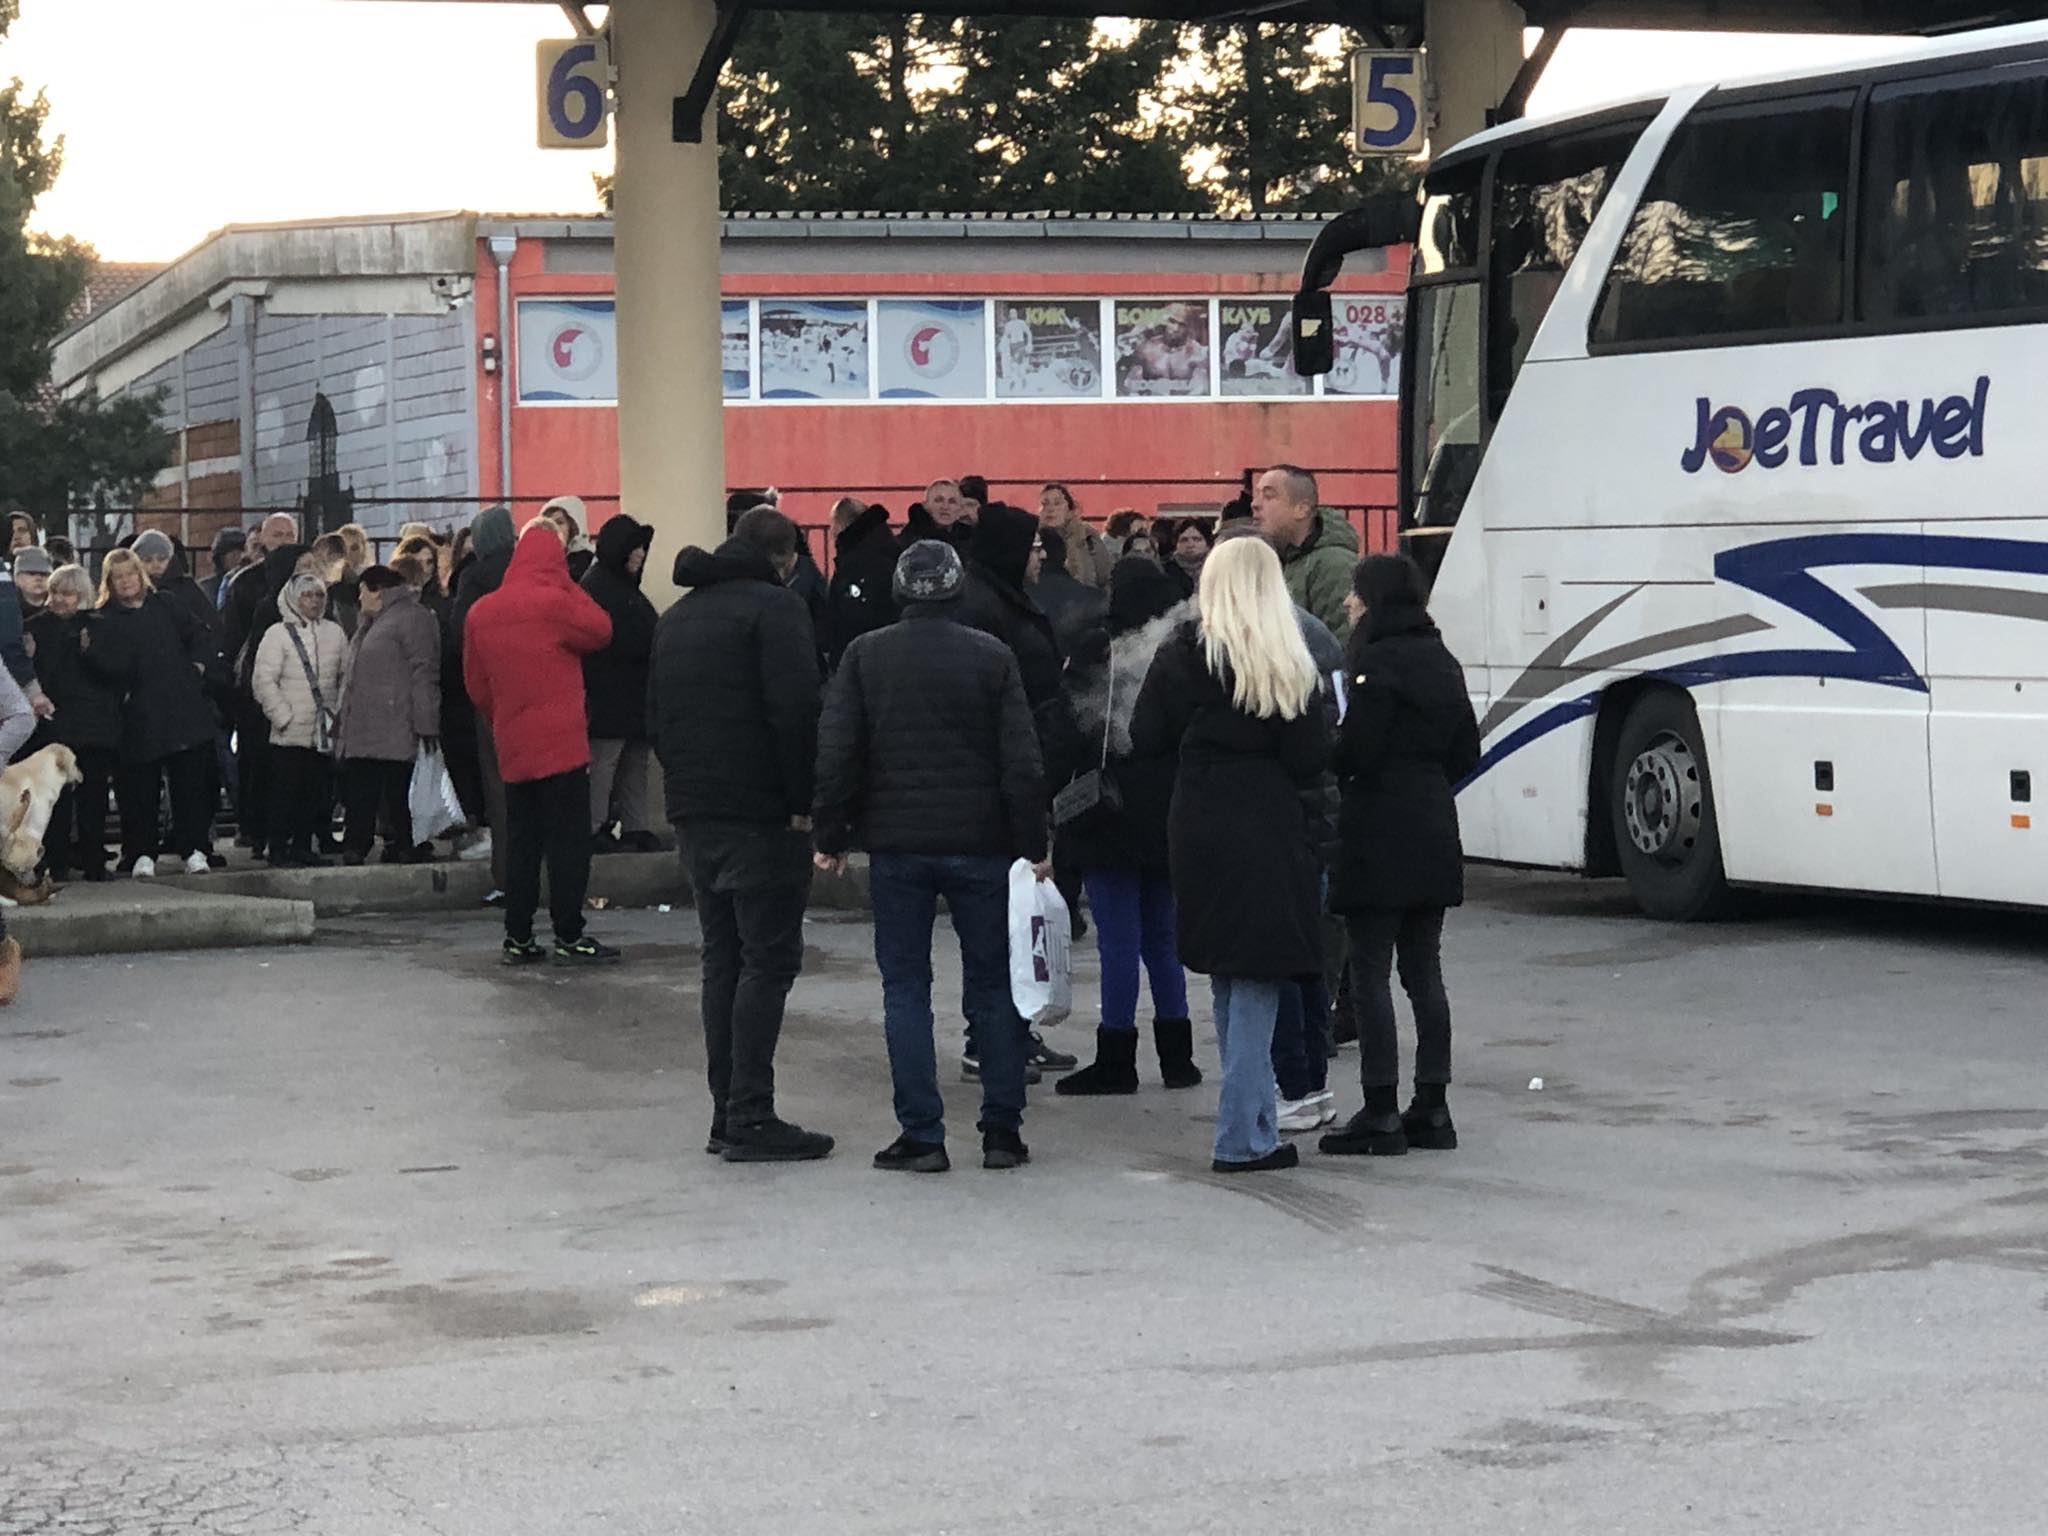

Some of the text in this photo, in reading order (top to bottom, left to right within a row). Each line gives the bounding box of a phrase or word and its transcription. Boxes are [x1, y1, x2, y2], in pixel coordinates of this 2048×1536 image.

[546, 43, 603, 139] 6
[1363, 57, 1416, 147] 5
[1221, 306, 1271, 325] КЛУБ
[1346, 305, 1387, 324] 028
